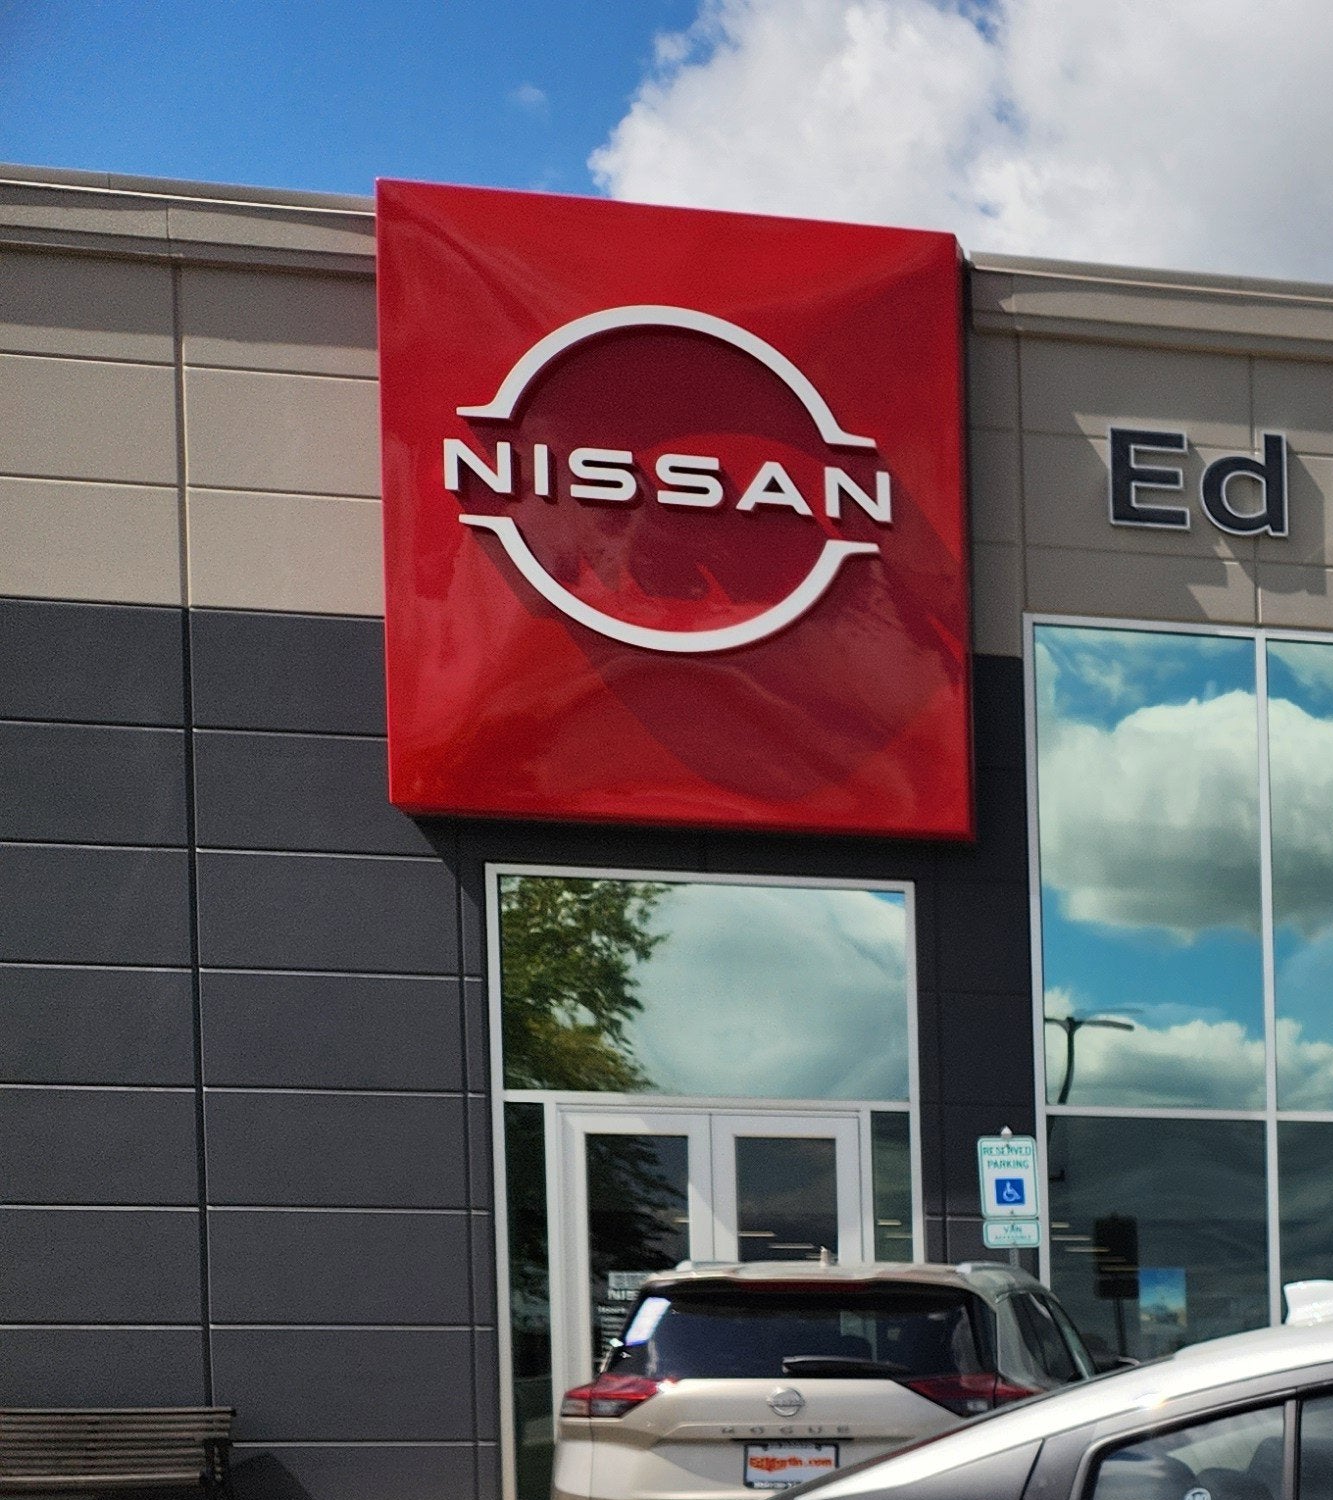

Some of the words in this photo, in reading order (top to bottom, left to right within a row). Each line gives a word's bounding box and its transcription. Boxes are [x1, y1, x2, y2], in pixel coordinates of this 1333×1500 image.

[444, 437, 892, 524] NISSAN
[1108, 426, 1290, 538] Ed
[982, 1146, 1032, 1156] RESERVED
[987, 1160, 1030, 1169] PARKING
